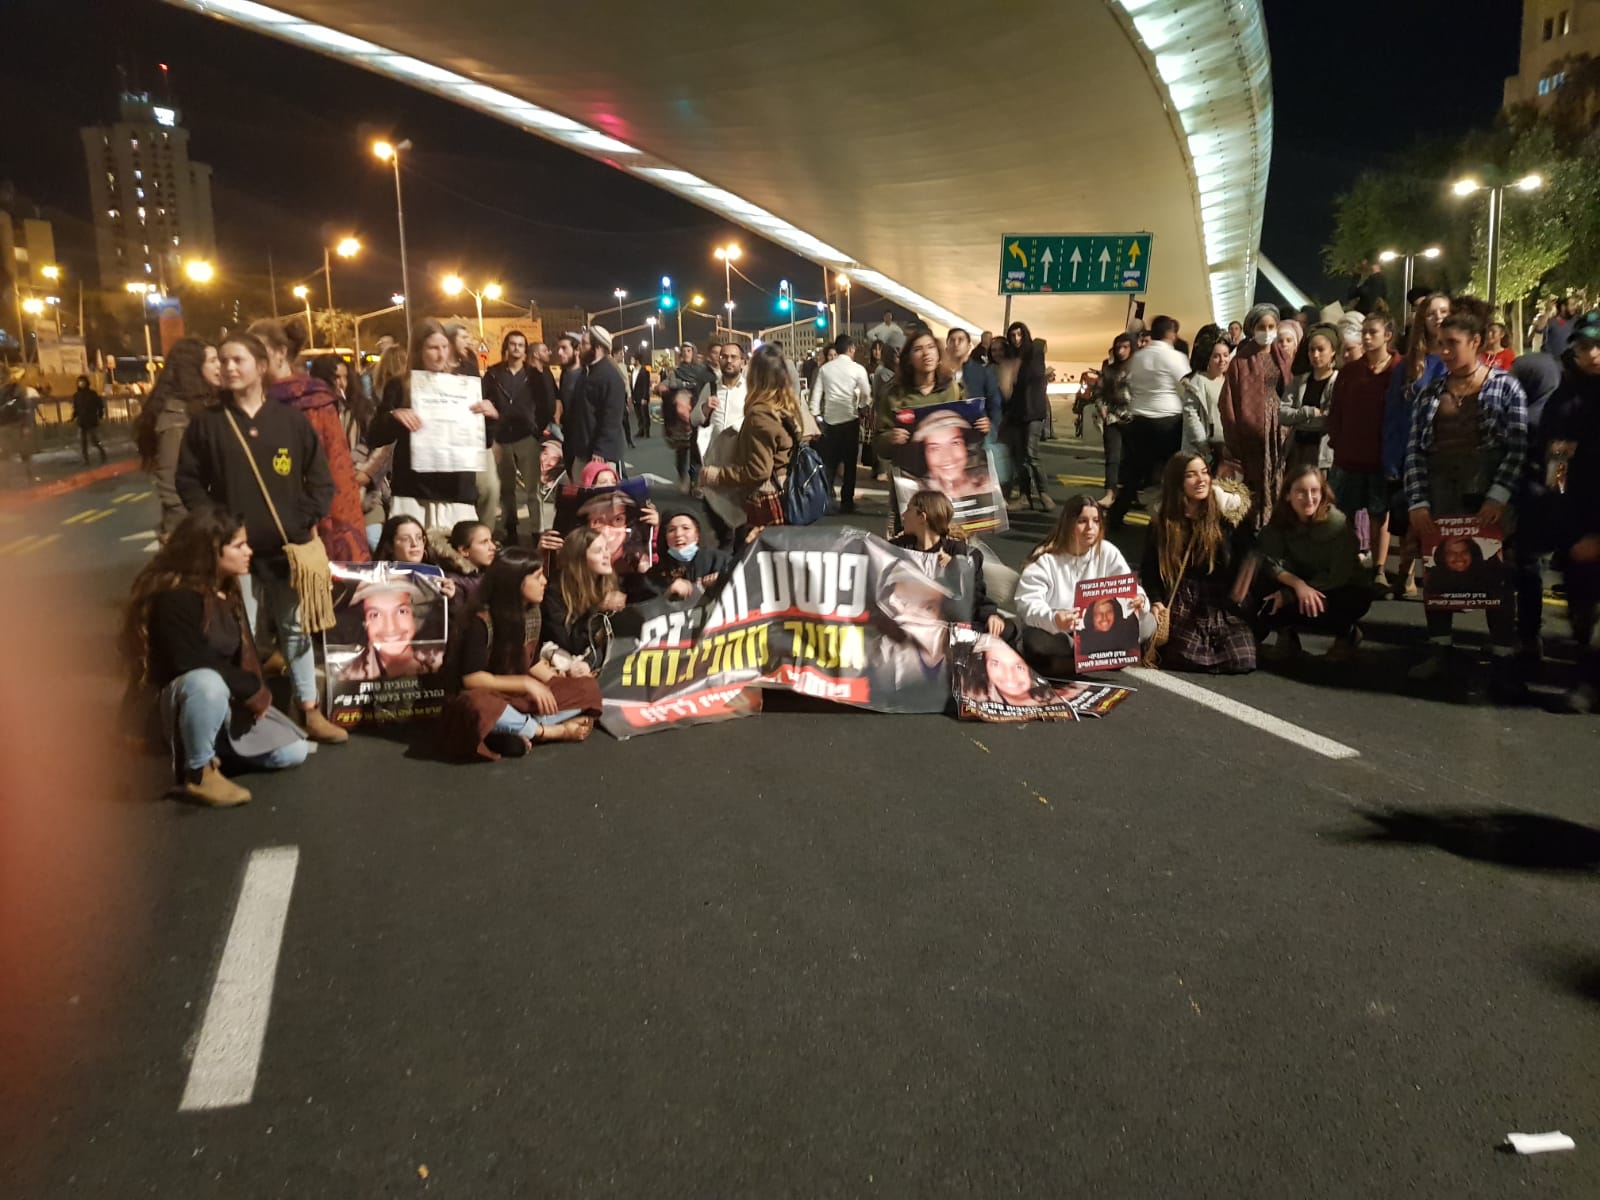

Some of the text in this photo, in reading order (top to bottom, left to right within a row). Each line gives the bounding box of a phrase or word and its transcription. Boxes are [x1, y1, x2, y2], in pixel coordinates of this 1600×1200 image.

[1440, 526, 1480, 536] עכשיו!
[756, 550, 868, 618] פשע
[1117, 578, 1126, 586] אני
[1101, 588, 1117, 596] מארץ
